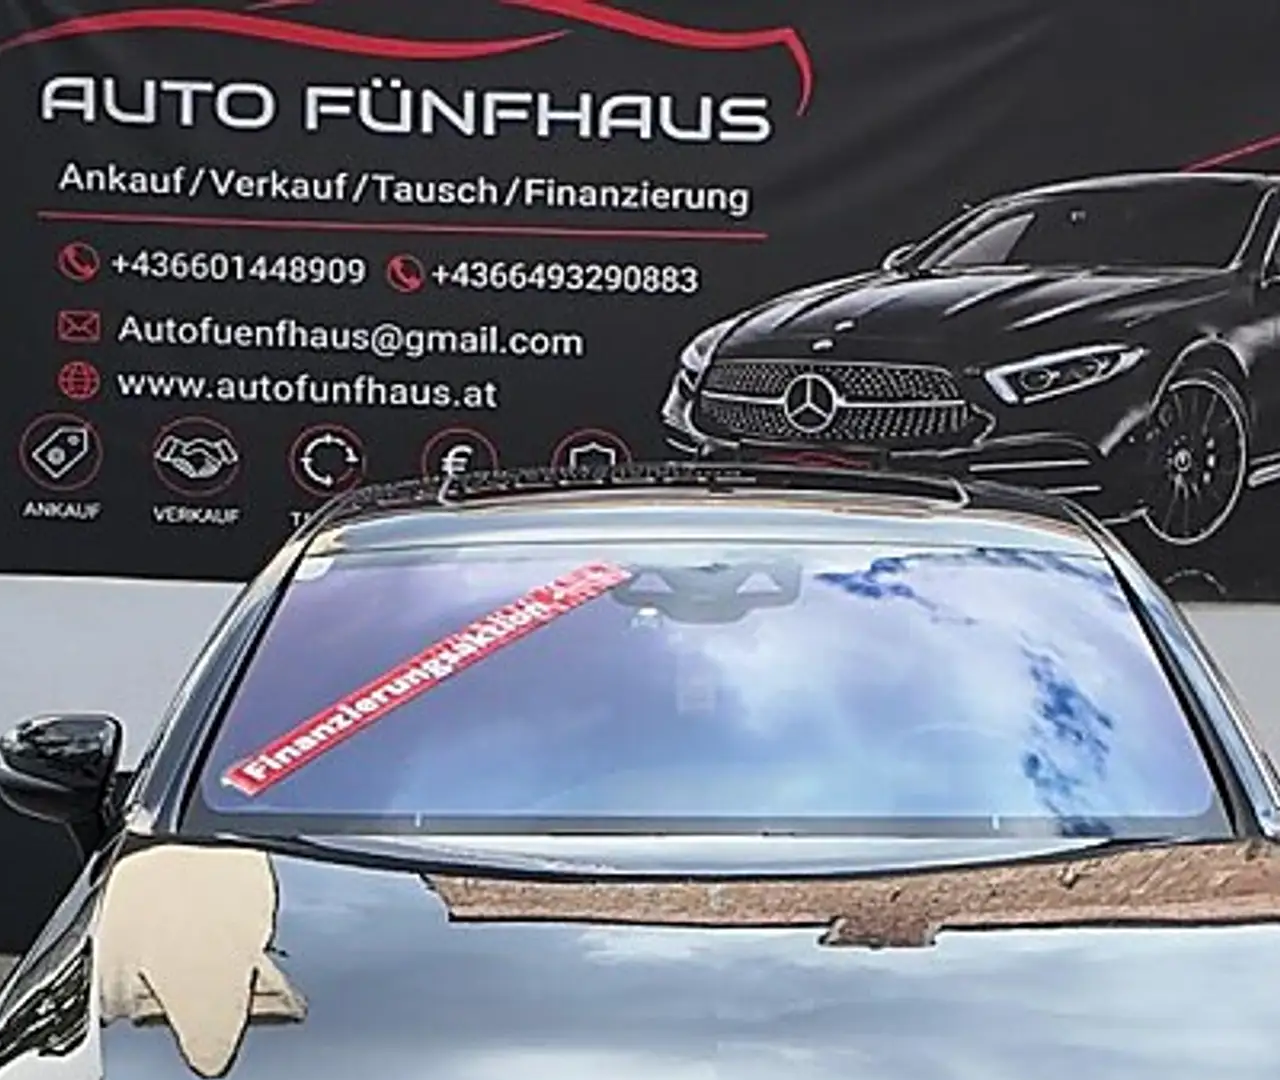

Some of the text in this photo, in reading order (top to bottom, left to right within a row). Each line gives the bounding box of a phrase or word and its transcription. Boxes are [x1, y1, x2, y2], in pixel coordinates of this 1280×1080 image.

[41, 76, 771, 143] AUTO FÜNFHAUS
[111, 252, 366, 284] +436601448909
[431, 261, 699, 293] +4366493290883
[118, 316, 583, 358] Autofuenfhaus@gmail.com
[118, 370, 497, 409] www.autofunfhaus.at
[22, 501, 101, 520] ANKAUF
[153, 506, 240, 525] VERKAUF
